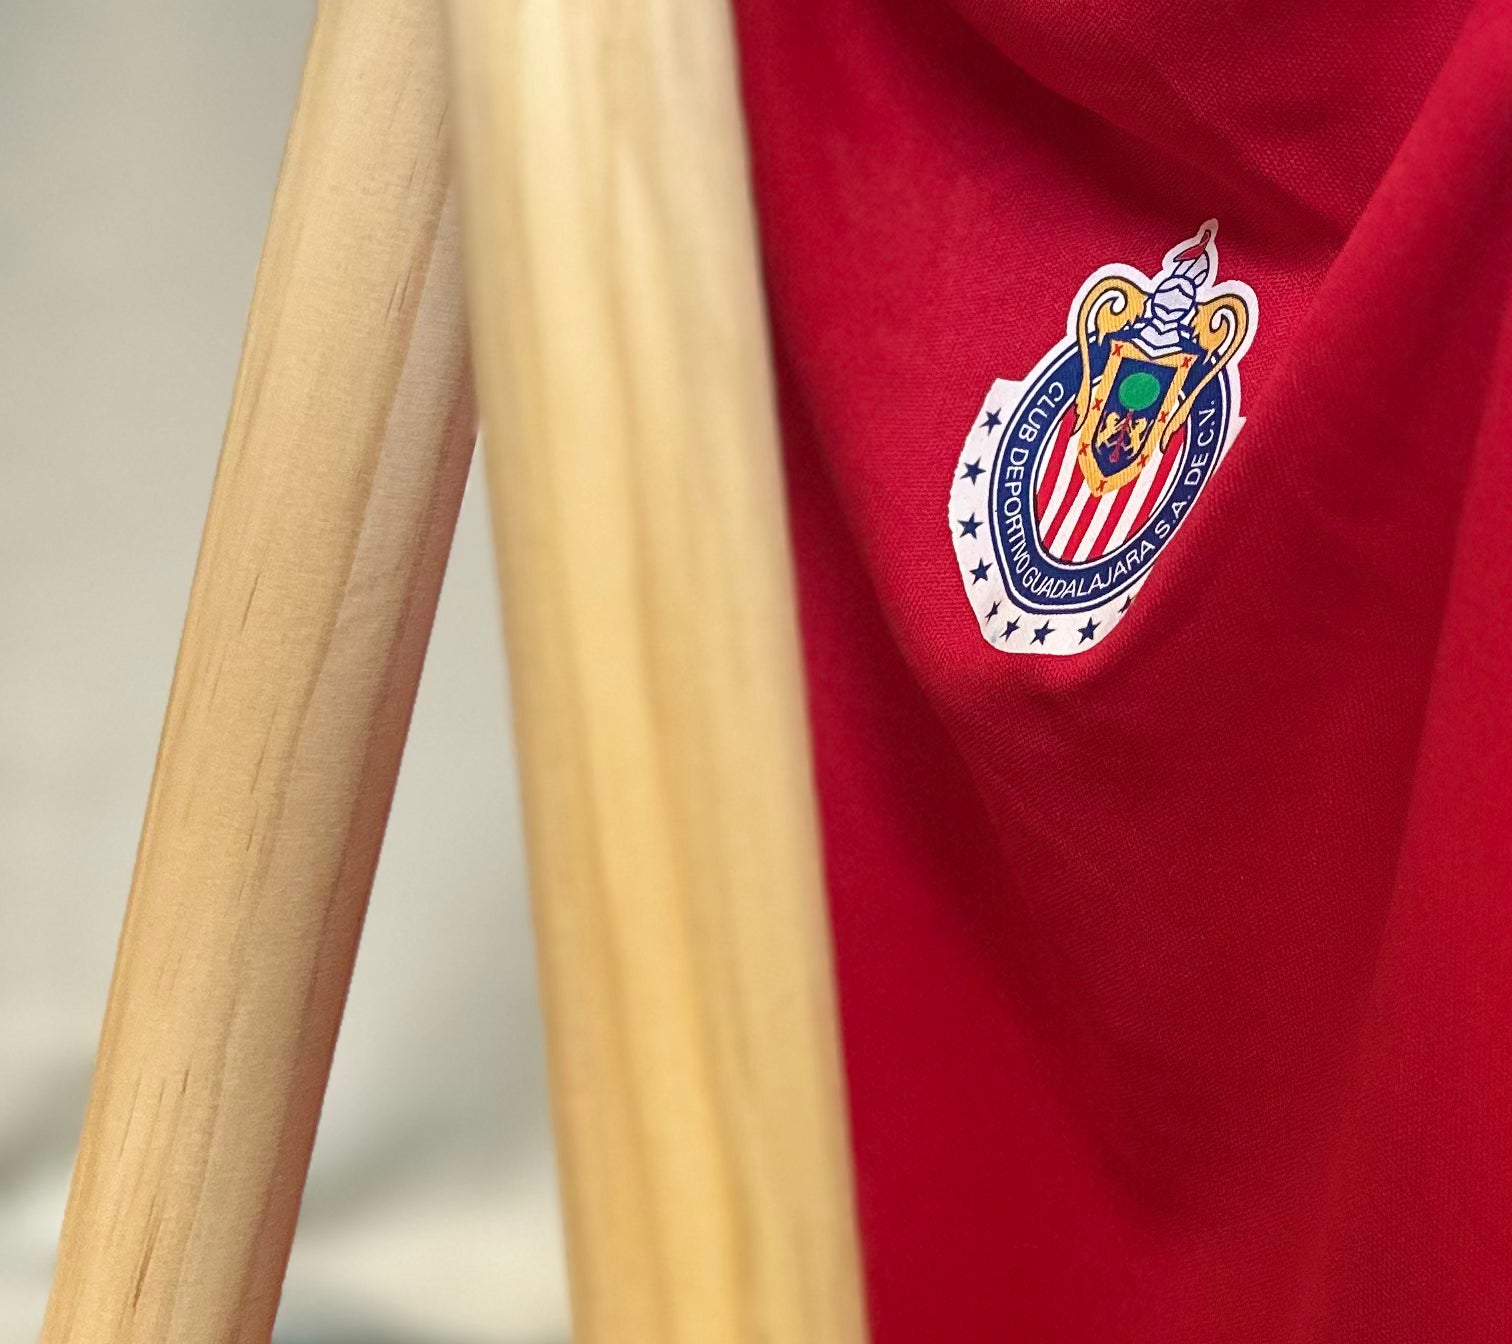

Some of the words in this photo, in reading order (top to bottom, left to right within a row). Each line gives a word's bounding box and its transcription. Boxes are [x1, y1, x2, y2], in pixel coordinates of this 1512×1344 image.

[1019, 381, 1064, 442] CLUB
[1184, 452, 1209, 485] DE
[1004, 447, 1030, 574] DEPORTIVO
[1022, 539, 1156, 598] GUADALAJARA
